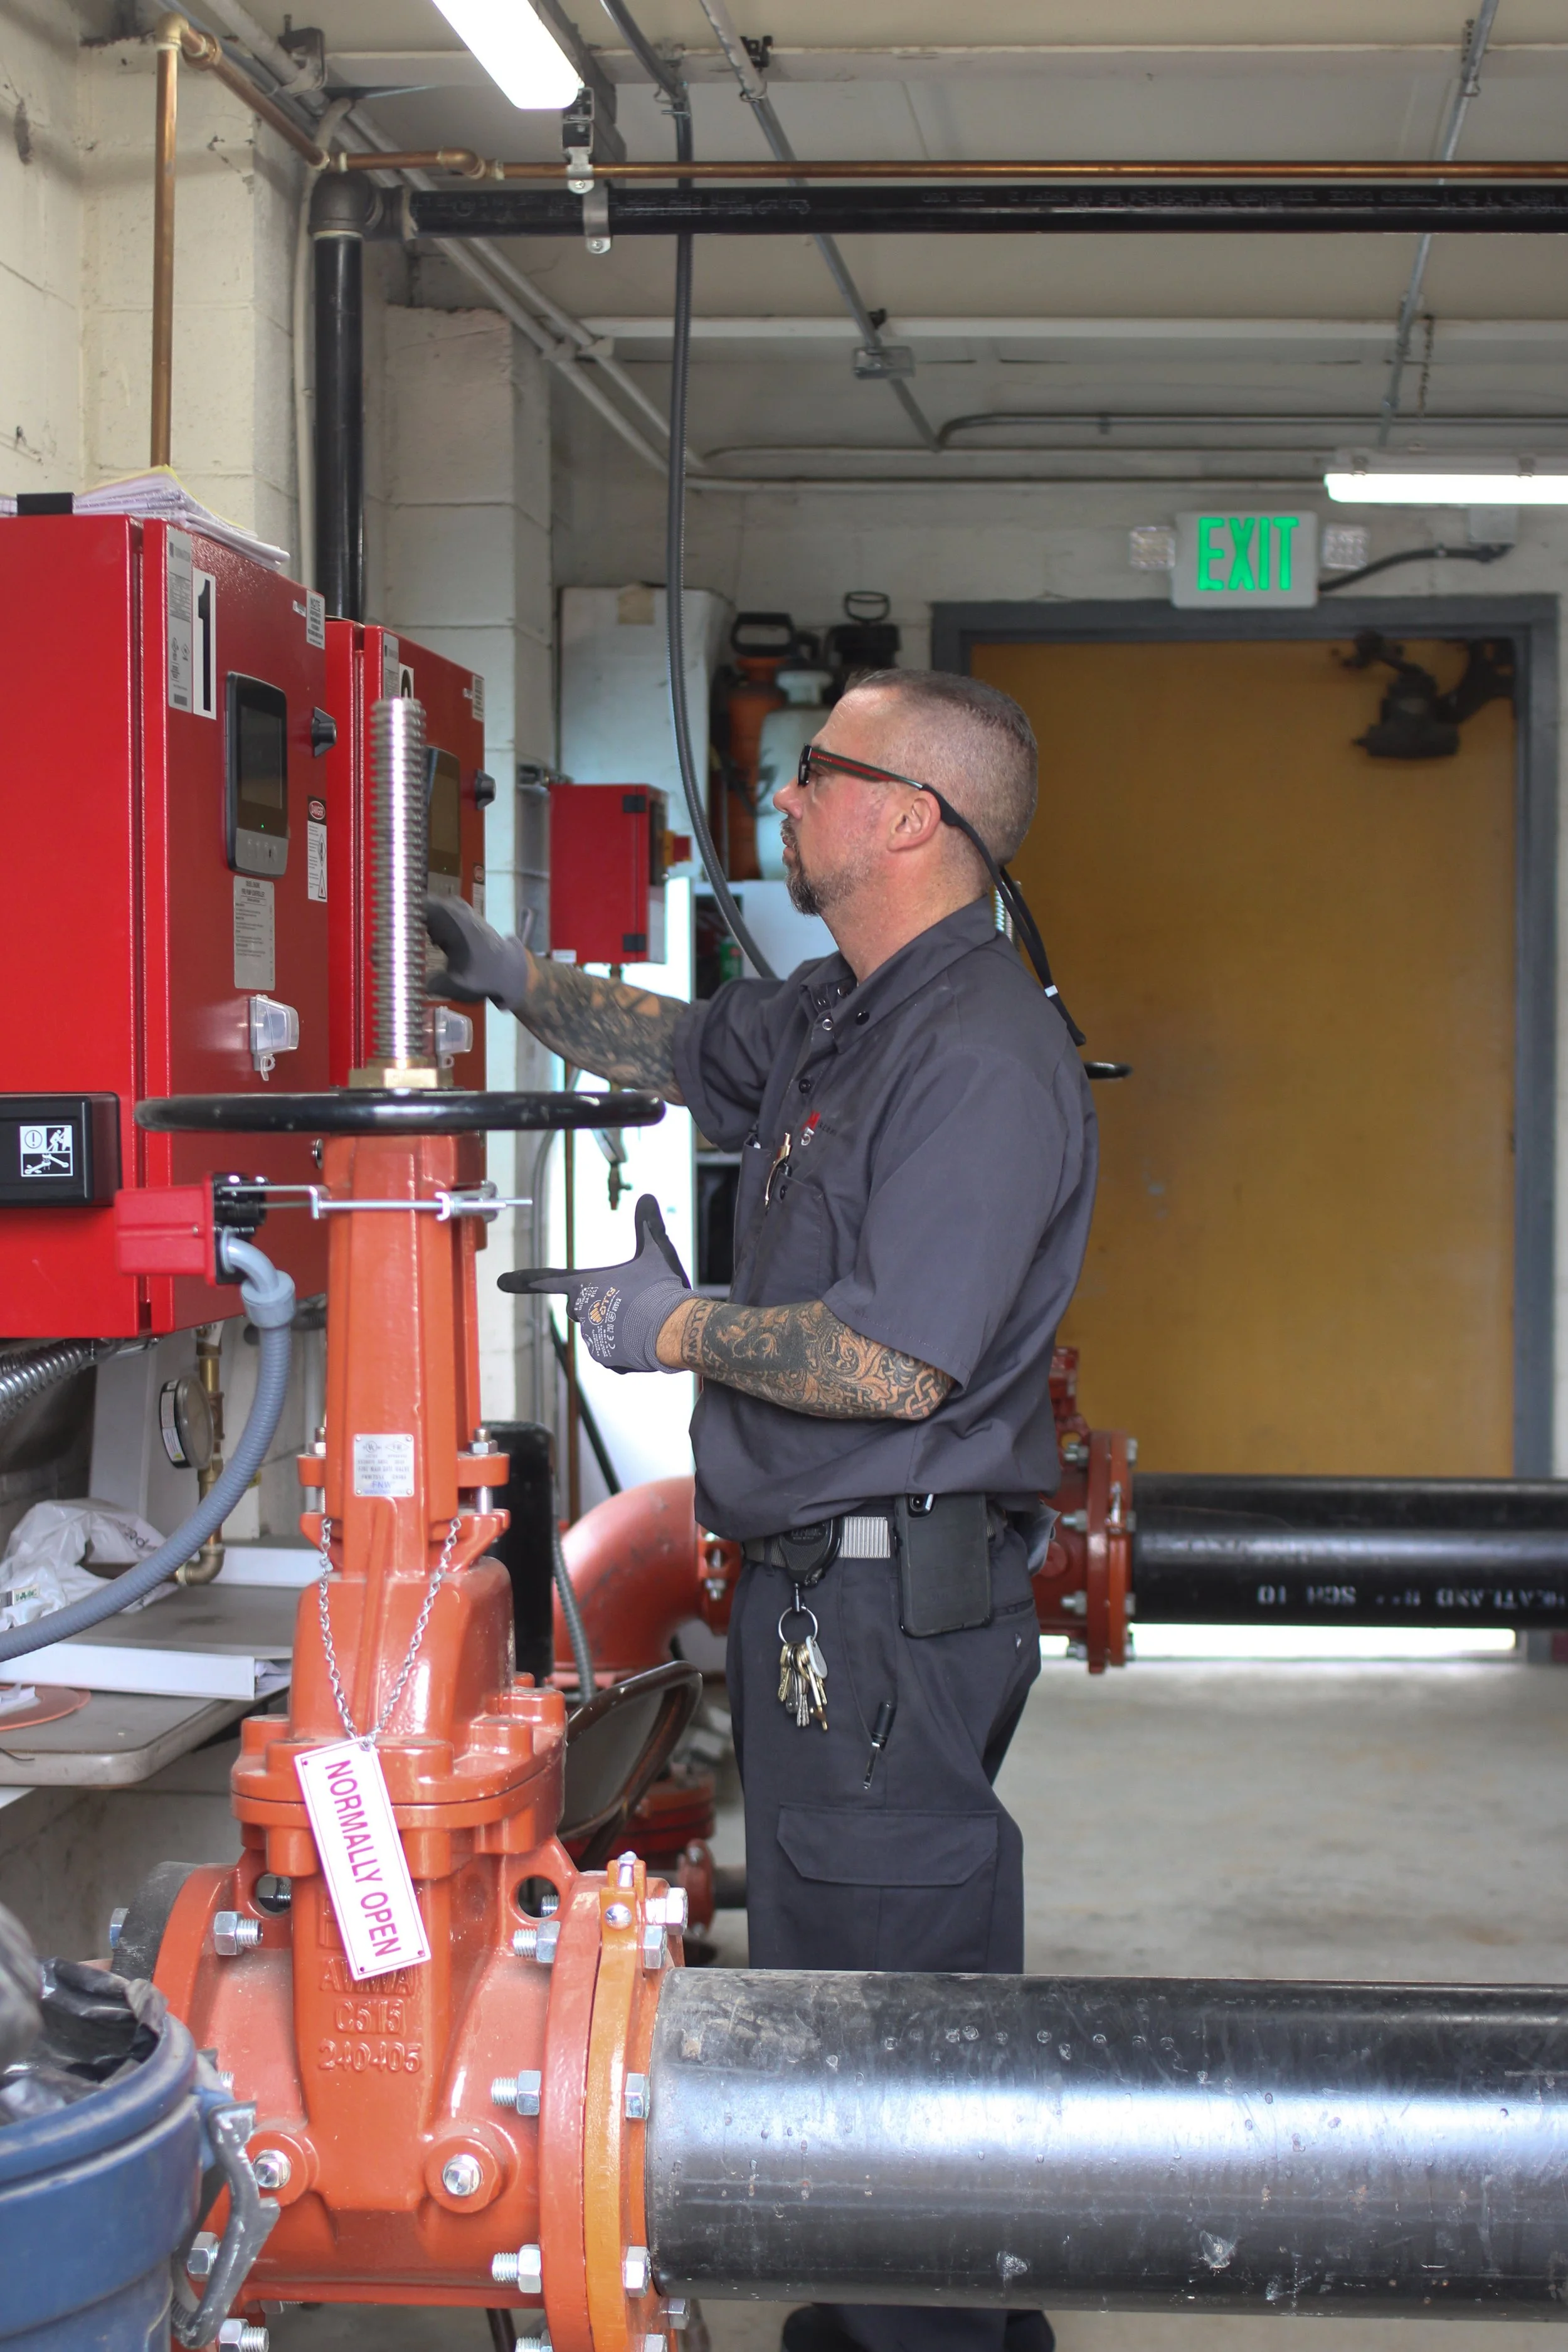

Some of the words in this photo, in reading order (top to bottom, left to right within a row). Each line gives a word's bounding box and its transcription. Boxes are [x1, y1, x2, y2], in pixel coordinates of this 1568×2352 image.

[1197, 517, 1300, 591] EXIT
[198, 578, 211, 712] 1
[326, 1761, 381, 1882] NORMALLY
[361, 1892, 401, 1956] OPEN
[336, 1999, 405, 2035] C515
[318, 2039, 422, 2074] 240405
